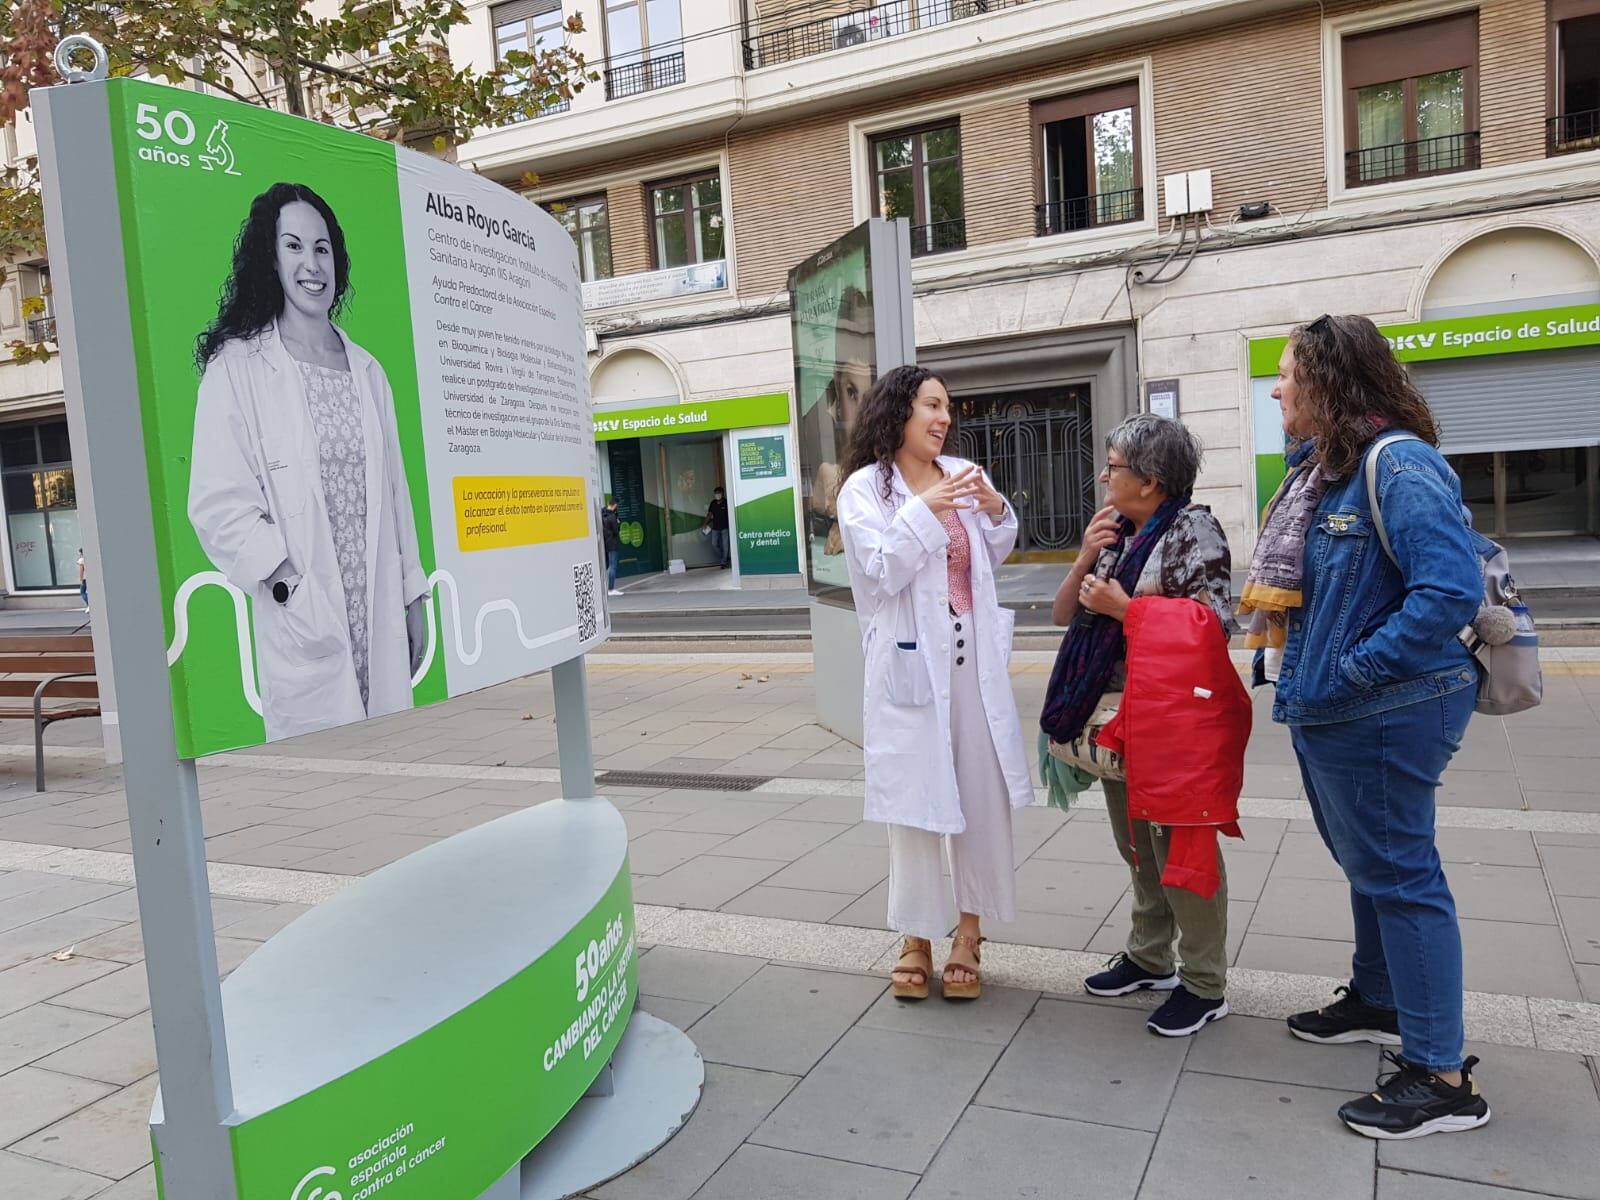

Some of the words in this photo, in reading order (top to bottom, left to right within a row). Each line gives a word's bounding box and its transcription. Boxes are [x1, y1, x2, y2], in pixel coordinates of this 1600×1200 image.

[136, 102, 196, 145] 50
[138, 145, 190, 167] años
[426, 192, 463, 222] Alba
[467, 205, 500, 237] Royo
[502, 220, 536, 251] García
[428, 228, 459, 248] Centro
[461, 238, 471, 252] de
[429, 248, 468, 269] Sanitaria
[469, 258, 497, 277] Aragón
[432, 275, 457, 291] Ayuda
[459, 280, 498, 302] Predoctoral
[498, 290, 506, 303] de
[506, 292, 512, 305] la
[434, 293, 460, 309] Contra
[462, 299, 469, 310] el
[436, 320, 460, 333] Desde
[462, 326, 476, 339] muy
[477, 328, 495, 340] joven
[495, 330, 502, 341] he
[1442, 325, 1512, 348] Espacio
[1517, 323, 1541, 339] de
[1546, 315, 1600, 336] Salud
[438, 339, 449, 349] en
[490, 348, 495, 359] y
[440, 355, 481, 370] Universidad
[467, 378, 476, 386] un
[507, 381, 515, 391] de
[443, 390, 484, 403] Universidad
[489, 394, 497, 404] de
[445, 407, 472, 420] técnico
[472, 410, 481, 420] de
[622, 415, 661, 431] Espacio
[662, 414, 676, 425] de
[678, 410, 708, 424] Salud
[447, 425, 454, 436] el
[480, 428, 489, 437] en
[462, 490, 473, 501] La
[474, 485, 506, 500] vocación
[506, 490, 511, 502] y
[512, 488, 518, 499] la
[464, 506, 497, 518] alcanzar
[498, 504, 505, 516] el
[505, 502, 520, 515] éxito
[521, 504, 536, 515] tanto
[739, 531, 763, 539] Centro
[764, 529, 791, 538] médico
[750, 540, 755, 549] y
[756, 537, 780, 547] dental
[543, 986, 607, 1072] CAMBIANDO
[607, 970, 618, 998] LA
[583, 1024, 602, 1061] DEL
[349, 1121, 414, 1168] asociación
[351, 1145, 407, 1186] española
[352, 1171, 394, 1200] contra
[396, 1160, 406, 1176] el
[408, 1136, 446, 1168] cáncer
